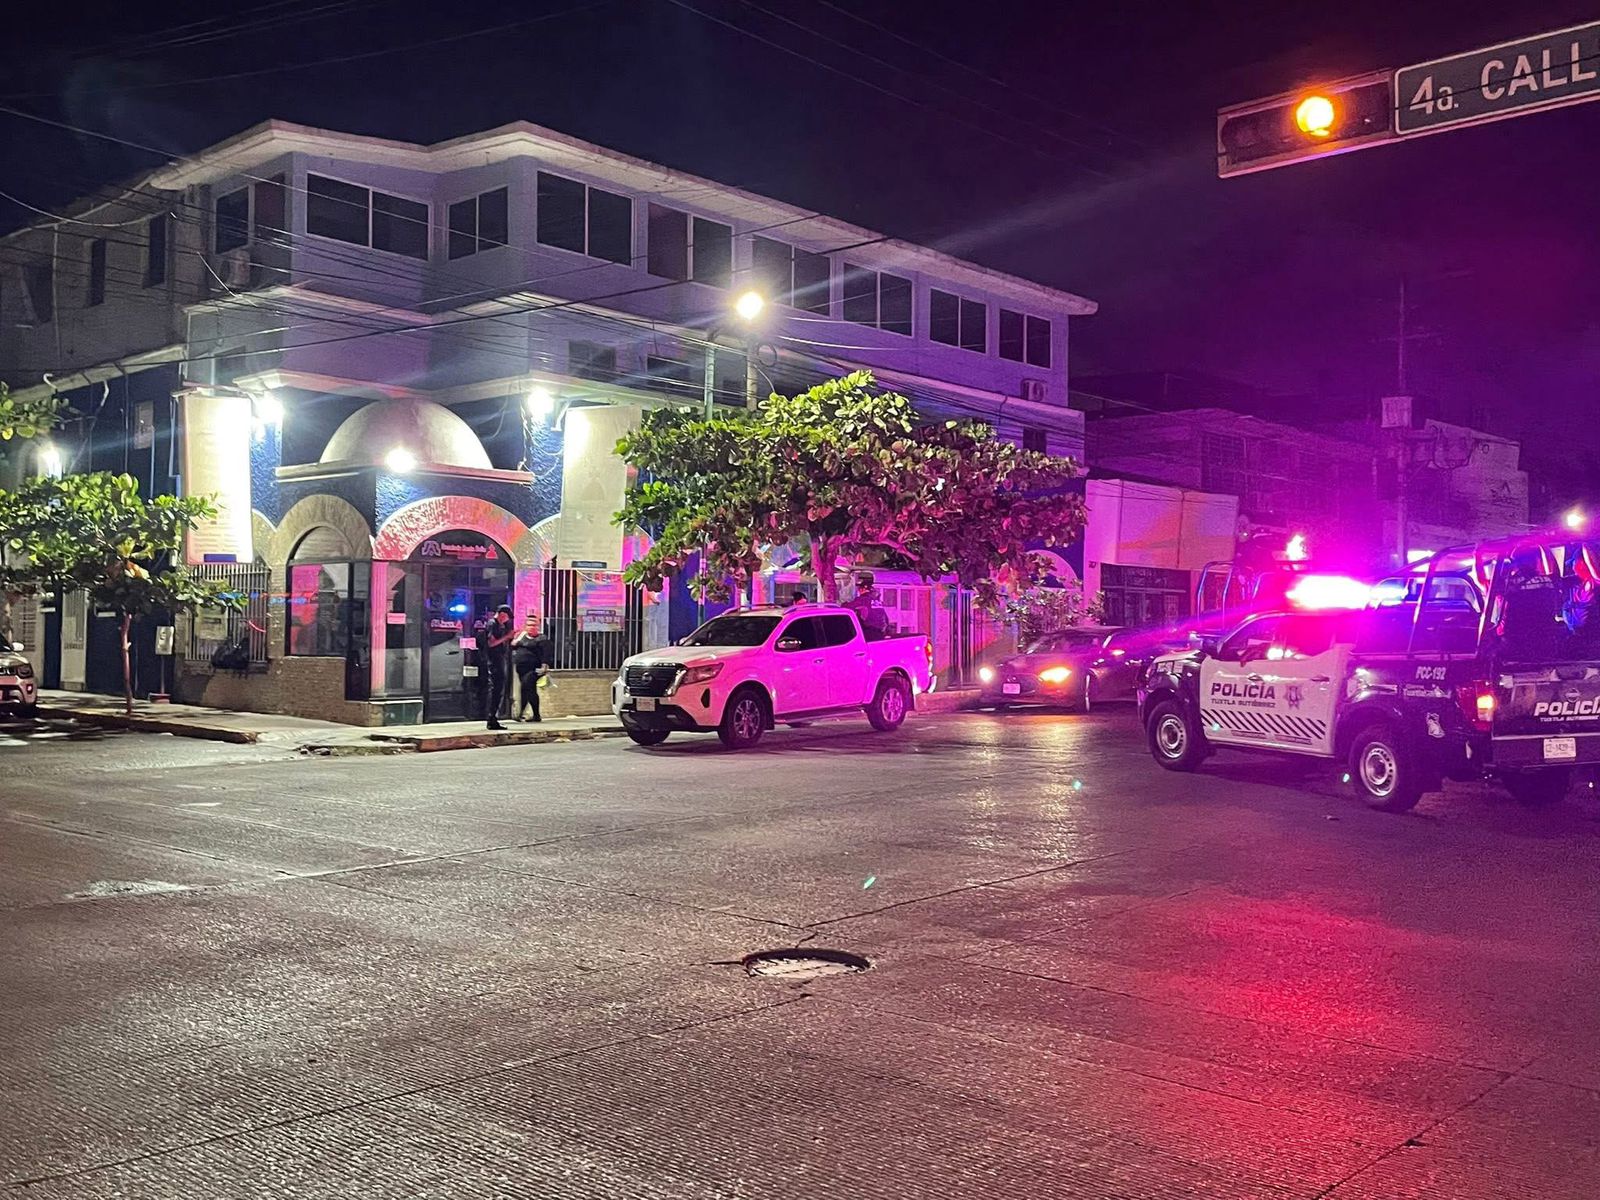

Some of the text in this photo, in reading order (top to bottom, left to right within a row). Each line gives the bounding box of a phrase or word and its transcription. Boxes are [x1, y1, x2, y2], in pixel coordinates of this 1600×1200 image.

[1409, 42, 1597, 115] 4a. CALL
[1211, 681, 1276, 700] POLICÍA
[1211, 698, 1236, 706] TUXTLA
